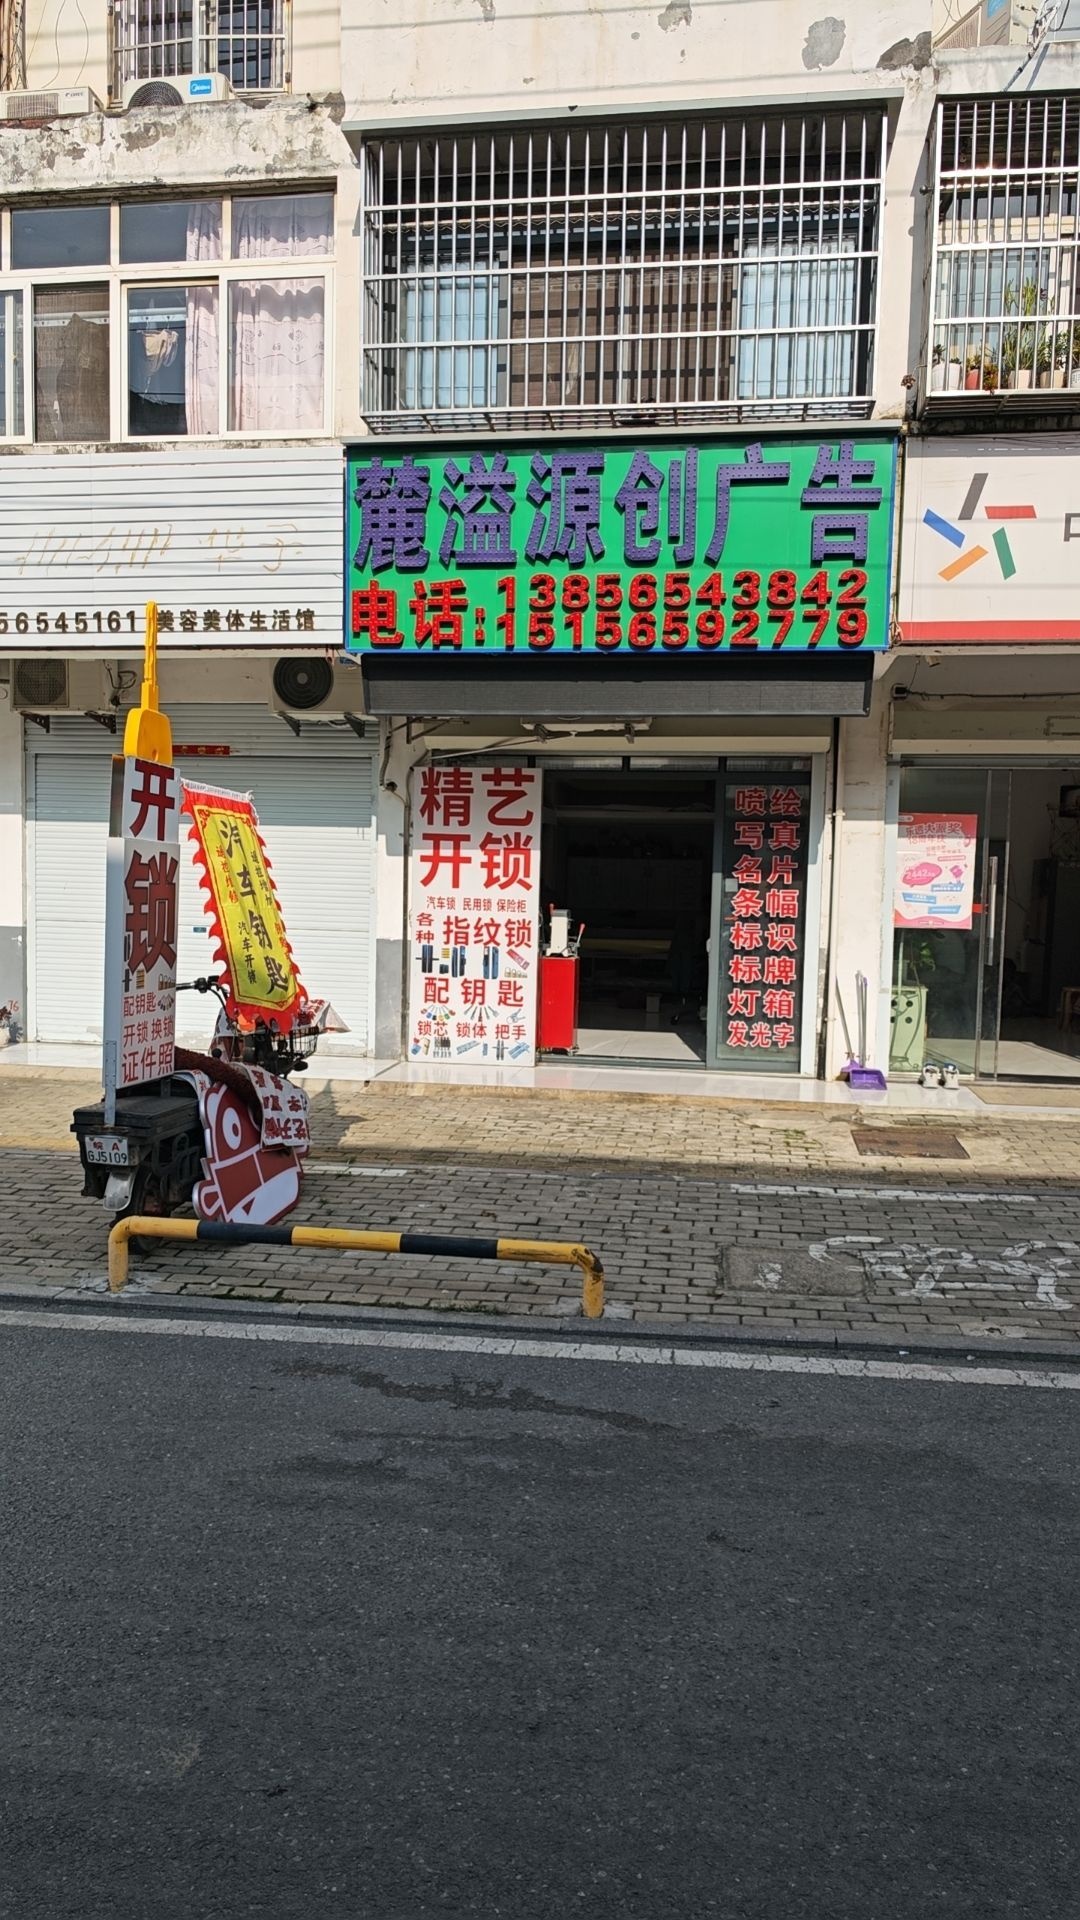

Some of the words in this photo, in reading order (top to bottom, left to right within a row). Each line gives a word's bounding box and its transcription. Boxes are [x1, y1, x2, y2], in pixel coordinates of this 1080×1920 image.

[353, 441, 883, 570] 麓溢源创广告
[497, 569, 868, 609] 13856543842
[0, 610, 137, 634] 56545161
[157, 608, 316, 633] 美容美体生活馆
[497, 607, 868, 647] 15156592779
[419, 767, 535, 827] 精艺
[735, 787, 801, 817] 喷绘
[734, 821, 801, 850] 写真
[124, 760, 179, 975] 开锁
[420, 831, 533, 891] 开锁
[732, 854, 798, 885] 名片
[220, 820, 290, 995] 汽车钥匙
[426, 895, 456, 911] 汽车锁
[463, 897, 493, 912] 民用锁
[496, 898, 527, 913] 保险柜
[731, 887, 800, 918] 条幅
[415, 912, 435, 945] 各种
[443, 915, 532, 949] 指纹锁
[729, 921, 798, 951] 标识
[728, 954, 796, 985] 标牌
[123, 991, 157, 1018] 配钥匙
[424, 976, 524, 1008] 配钥匙
[727, 987, 796, 1018] 灯箱
[123, 1020, 149, 1048] 开锁
[417, 1020, 449, 1037] 锁芯
[456, 1021, 487, 1039] 锁体
[495, 1023, 527, 1041] 把手
[727, 1020, 795, 1049] 发光字
[122, 1041, 175, 1084] 证件照
[87, 1151, 128, 1164] GJ5109
